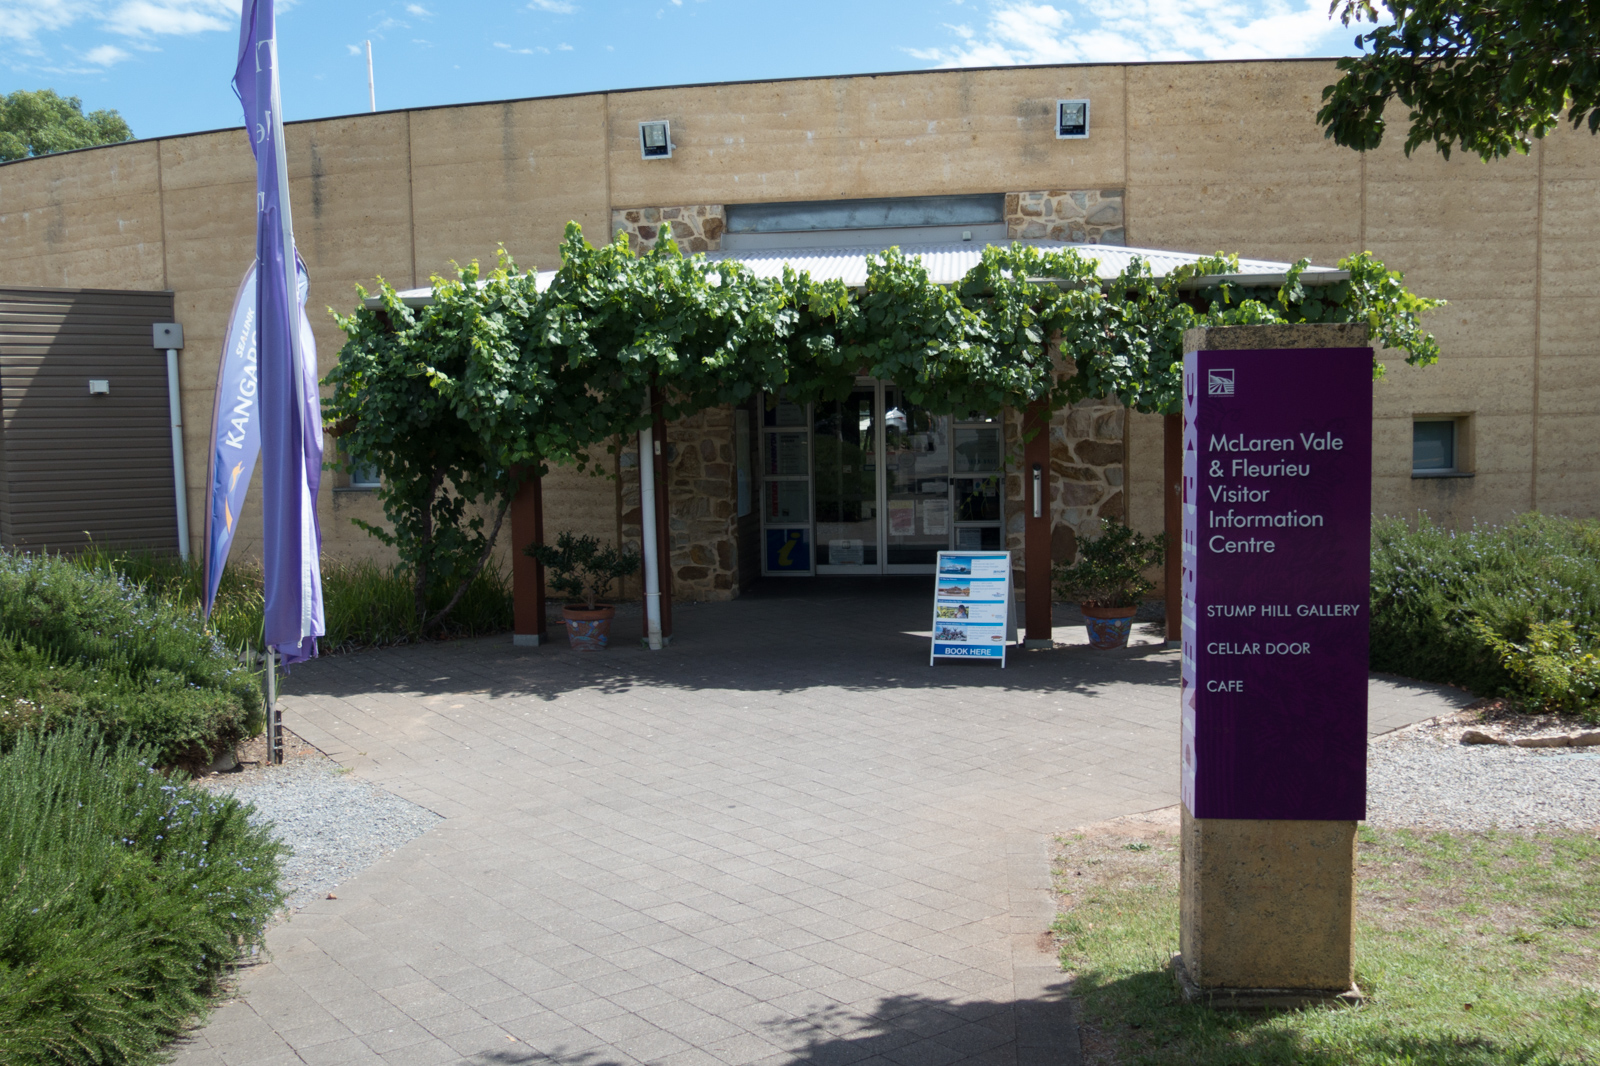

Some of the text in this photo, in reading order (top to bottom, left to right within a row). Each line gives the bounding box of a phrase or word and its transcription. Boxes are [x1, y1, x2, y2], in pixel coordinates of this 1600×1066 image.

[235, 306, 255, 359] SEALINK
[225, 330, 258, 450] KANGAR
[1208, 431, 1344, 452] McLaren Vale
[1208, 458, 1310, 478] & Fleurieu
[1208, 485, 1270, 503] Visitor
[1209, 509, 1324, 528] Information
[1208, 535, 1276, 554] Centre
[1206, 604, 1360, 618] STUMP HILL GALLERY
[944, 647, 992, 656] BOOK HERE
[1206, 642, 1311, 655] CELLAR DOOR
[1206, 680, 1244, 693] CAFE
